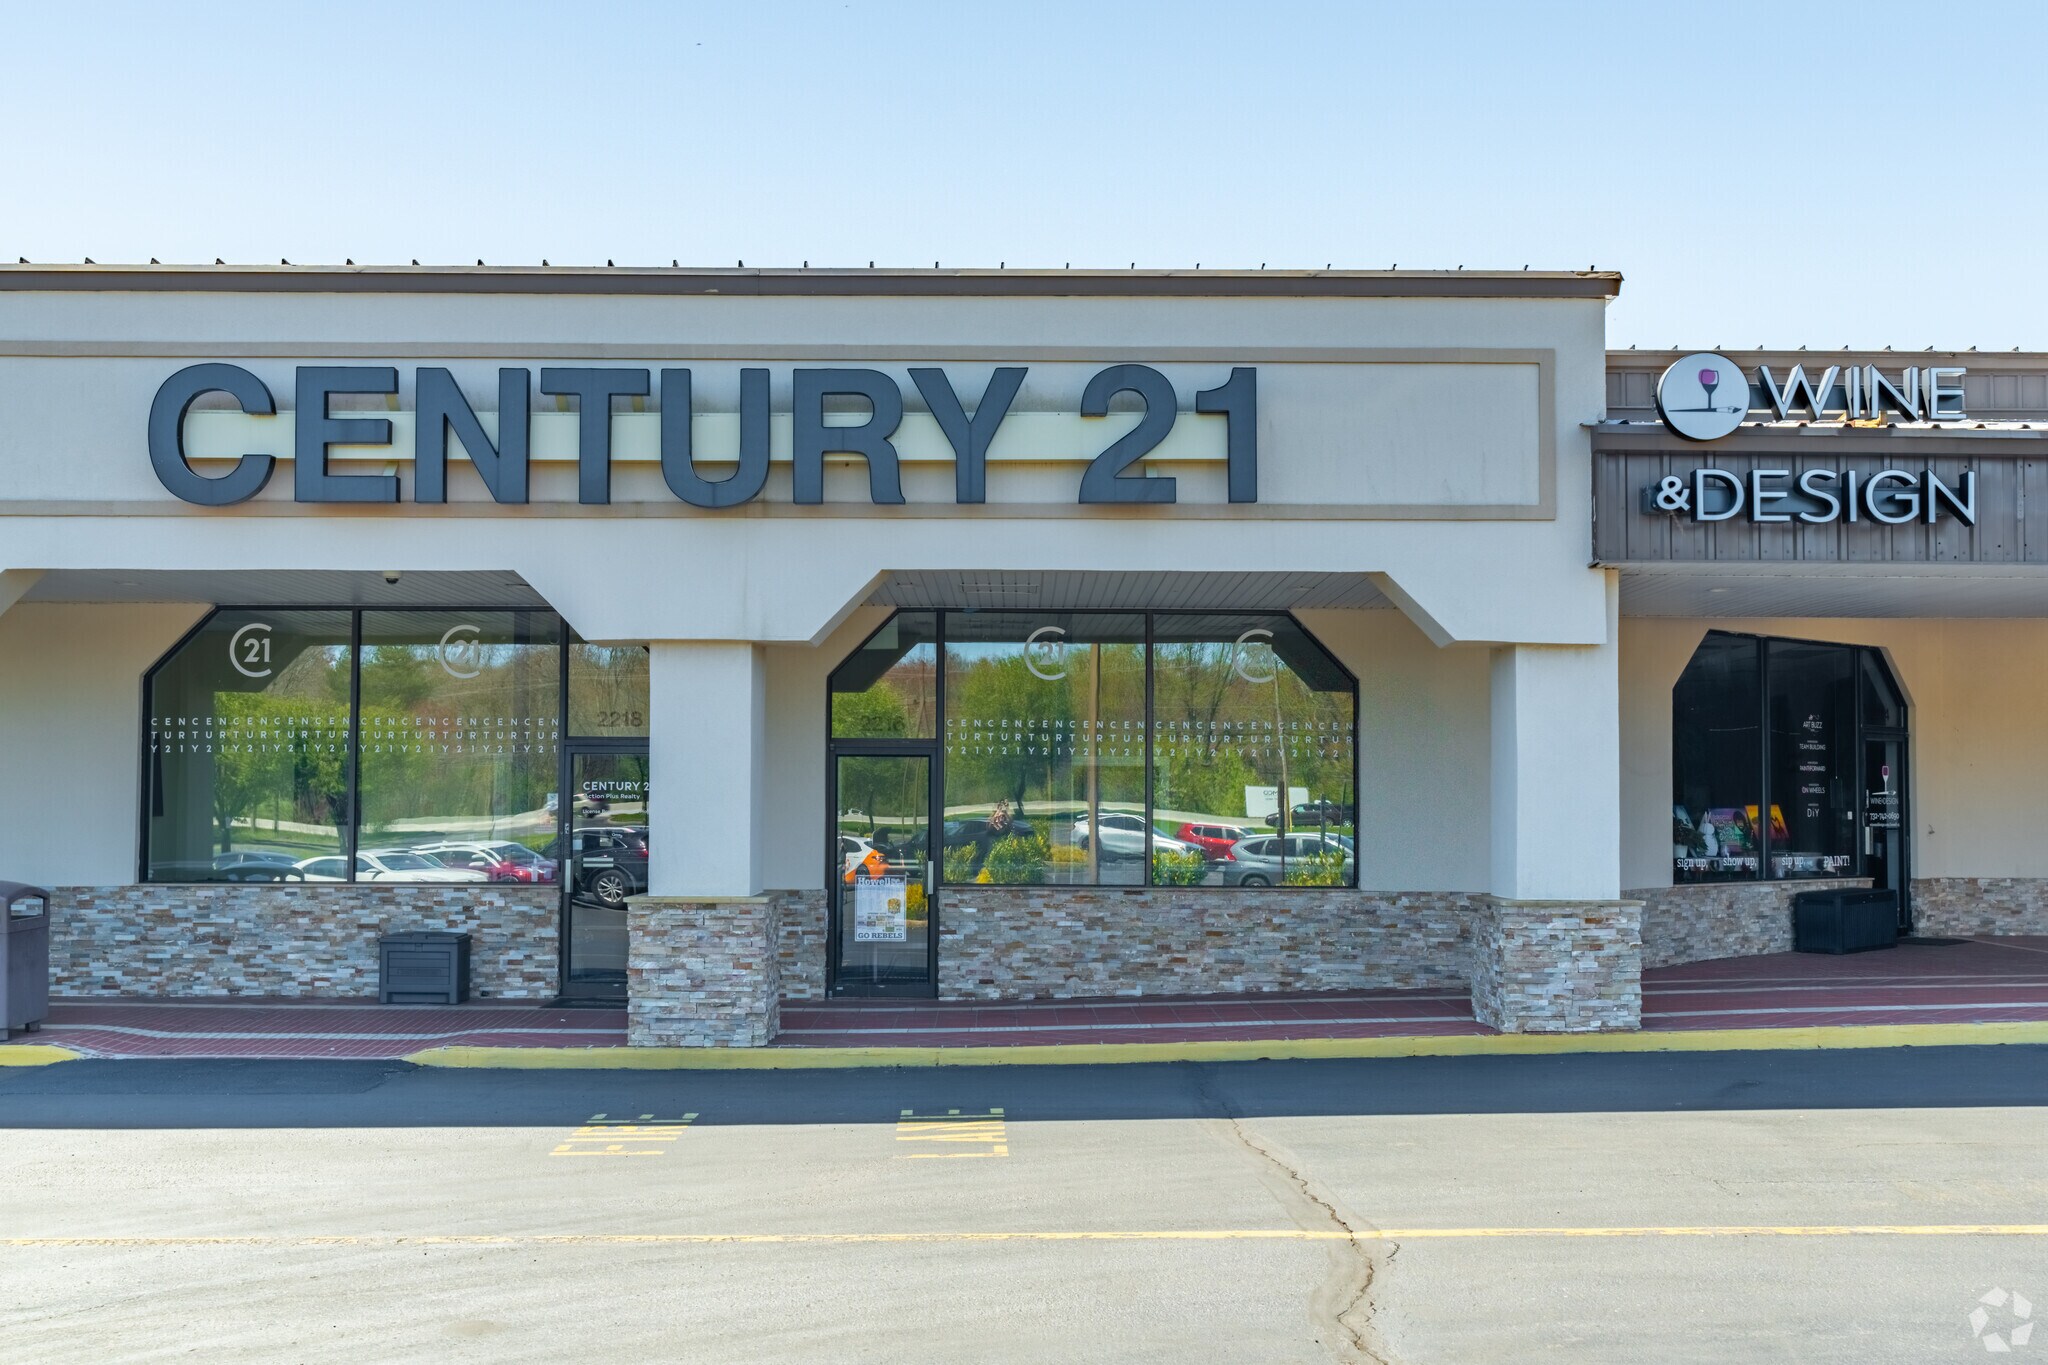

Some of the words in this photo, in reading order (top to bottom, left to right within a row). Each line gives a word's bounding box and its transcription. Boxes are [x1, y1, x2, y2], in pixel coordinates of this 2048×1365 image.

[1754, 363, 1967, 422] WINE
[146, 364, 1030, 509] CENTURY
[1078, 364, 1257, 504] 21
[597, 711, 643, 727] 2218
[583, 781, 640, 791] CENTURY
[1677, 856, 1694, 870] sign
[1695, 859, 1709, 871] up,
[1723, 853, 1743, 866] show
[1745, 857, 1757, 868] up,
[1781, 853, 1793, 868] sip
[1823, 855, 1850, 867] PAINT!
[549, 1113, 699, 1156] FIRE
[894, 1107, 1009, 1159] LANE
